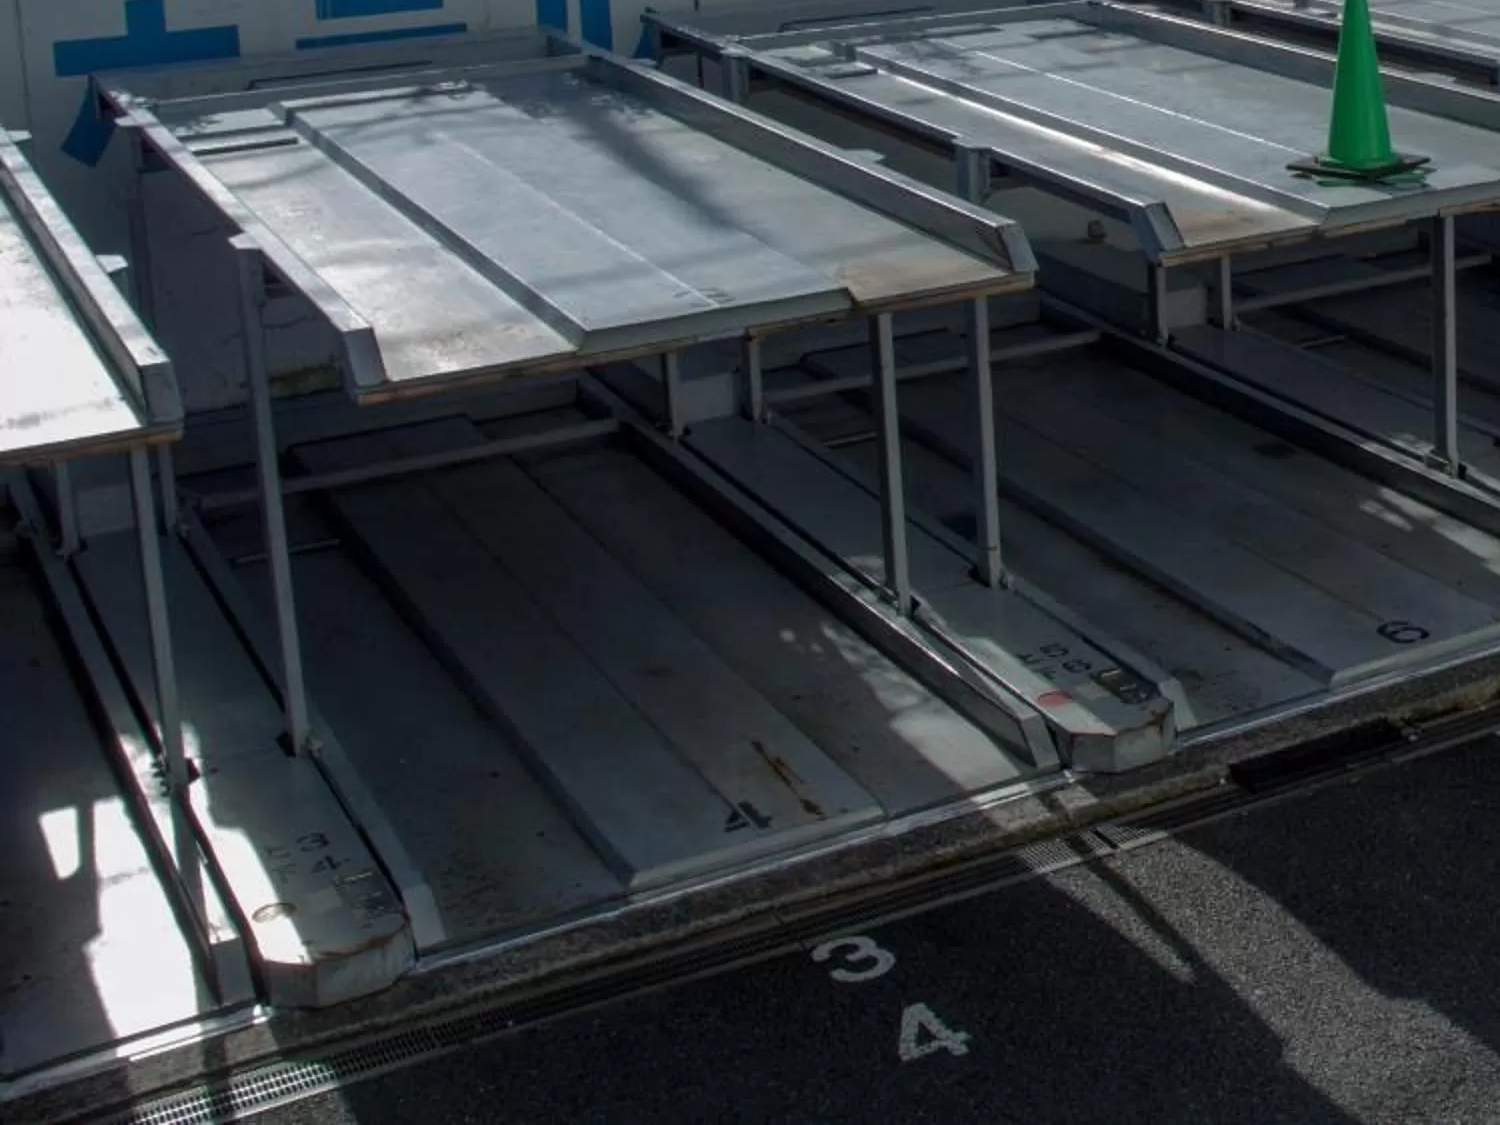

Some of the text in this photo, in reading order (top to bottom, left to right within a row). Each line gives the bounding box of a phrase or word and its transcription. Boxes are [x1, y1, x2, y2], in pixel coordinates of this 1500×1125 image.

[1376, 620, 1430, 644] 6
[724, 801, 772, 832] 4
[811, 935, 897, 983] 3
[900, 1001, 975, 1063] 4
